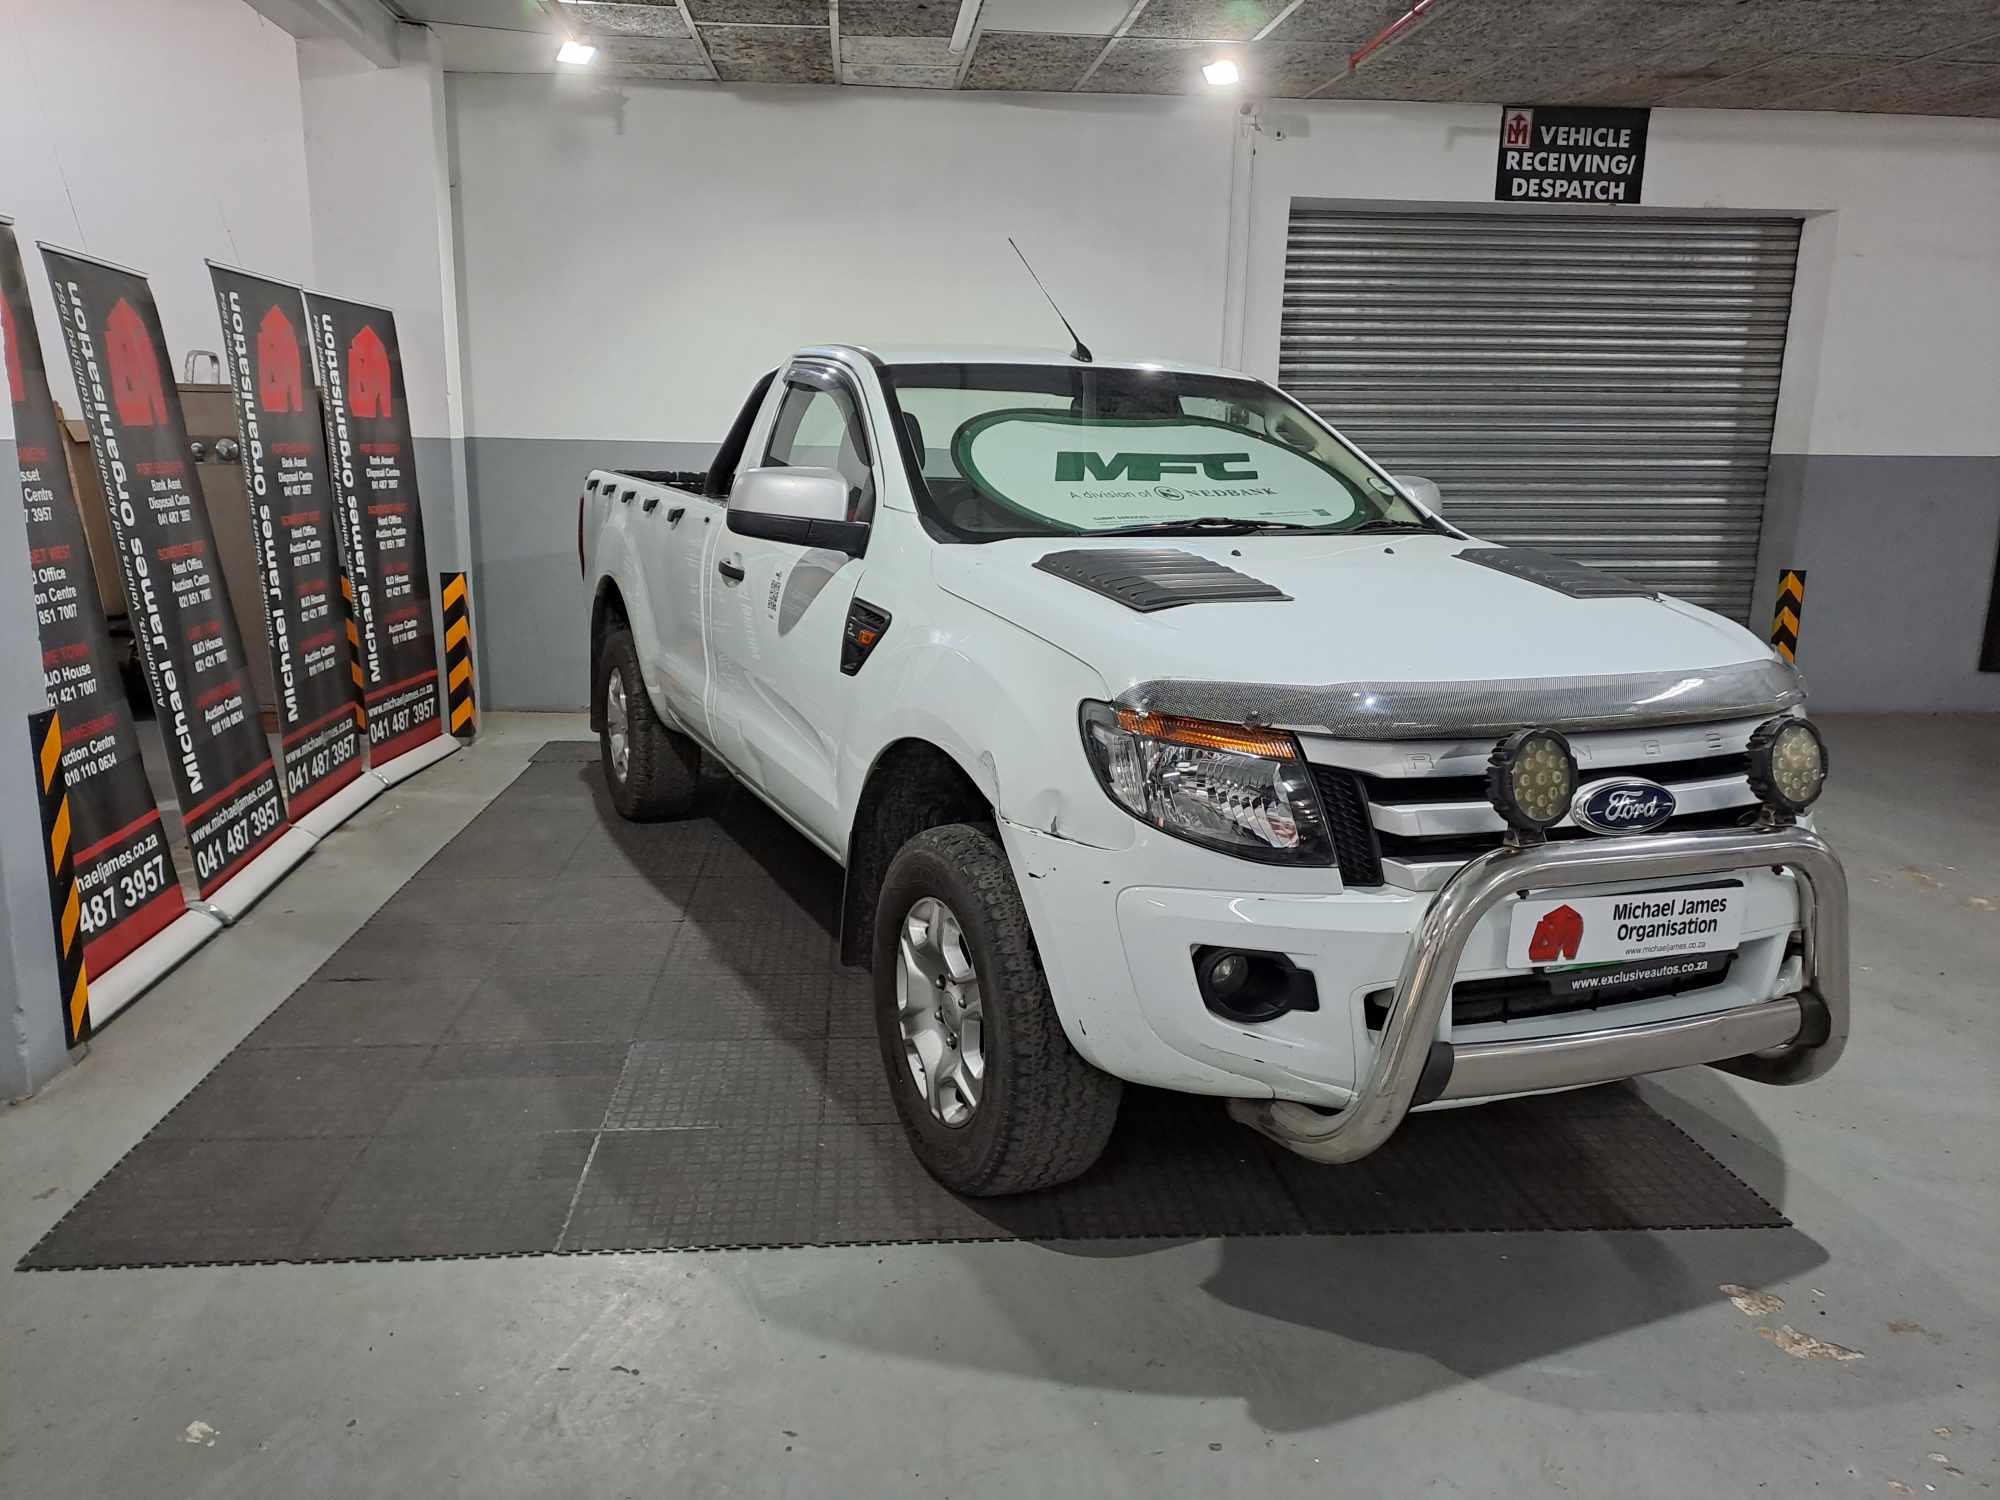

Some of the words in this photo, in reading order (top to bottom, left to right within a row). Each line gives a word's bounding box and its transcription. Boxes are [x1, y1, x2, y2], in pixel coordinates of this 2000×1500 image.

[1540, 126, 1632, 148] VEHICLE
[1505, 151, 1637, 175] RECEIVING/
[1511, 177, 1626, 200] DESPATCH
[65, 326, 95, 420] Established
[67, 281, 136, 527] Organisation
[229, 291, 267, 496] Organisation
[322, 314, 355, 489] Organisation
[20, 468, 41, 482] sset
[93, 434, 118, 517] Appraisers
[1054, 451, 1259, 482] MFC
[24, 487, 54, 502] Centre
[1082, 488, 1137, 499] division
[1138, 488, 1153, 499] of
[1184, 487, 1279, 498] NEDBANK
[31, 506, 52, 522] 3957
[112, 520, 126, 551] and
[347, 495, 367, 579] James
[260, 504, 282, 601] James
[38, 566, 67, 583] Office
[122, 555, 141, 611] Valuers
[49, 586, 77, 601] Centre
[130, 537, 168, 651] James
[38, 608, 56, 625] 851
[57, 603, 78, 620] 7007
[358, 584, 381, 683] Michael
[61, 663, 92, 681] House
[272, 609, 299, 723] Michael
[60, 685, 77, 703] 421
[78, 678, 97, 697] 7007
[158, 660, 204, 795] Michael
[370, 717, 390, 744] 041
[391, 708, 410, 733] 487
[412, 697, 435, 724] 3957
[61, 747, 89, 767] uction
[89, 735, 116, 754] Centre
[287, 762, 309, 794] 041
[311, 748, 330, 778] 487
[331, 733, 355, 766] 3957
[64, 767, 80, 787] 010
[80, 761, 97, 779] 110
[98, 752, 117, 772] 0634
[190, 779, 274, 844] www.michaeljames.co.za
[1604, 789, 1661, 822] Ford
[197, 838, 225, 879] 041
[226, 818, 250, 855] 487
[250, 796, 280, 837] 3957
[74, 833, 159, 893] haeljames.co.za
[80, 886, 117, 934] 487
[120, 854, 165, 908] 3957
[1613, 899, 1675, 921] Michael
[1679, 896, 1728, 916] James
[1617, 916, 1718, 944] Organisation
[1625, 940, 1707, 957] www.michaeljames.co.za
[1572, 959, 1709, 990] www.exclusiveautos.co.za
